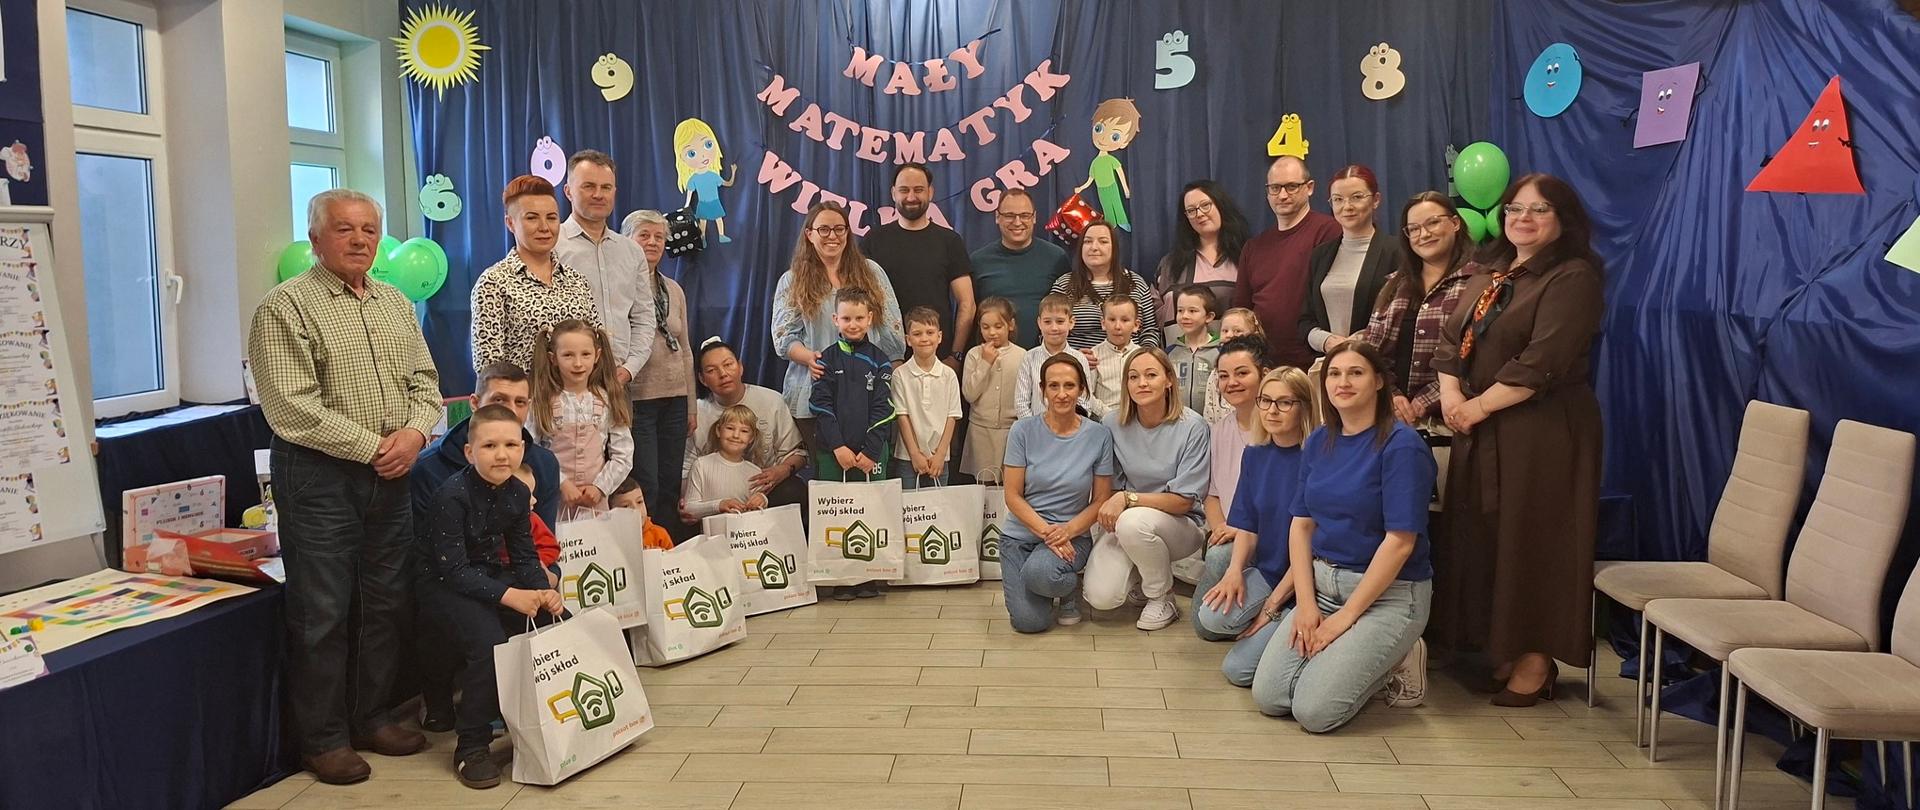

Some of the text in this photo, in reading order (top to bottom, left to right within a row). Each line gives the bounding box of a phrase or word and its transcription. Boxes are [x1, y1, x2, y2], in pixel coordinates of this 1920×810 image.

[843, 40, 985, 95] MAŁY
[1155, 30, 1196, 90] 5
[1360, 42, 1406, 100] 8
[757, 59, 1071, 165] MATEMATYK
[1267, 113, 1310, 160] 4
[970, 139, 1070, 213] GRA
[419, 173, 463, 222] 6
[0, 236, 29, 250] RZY
[817, 496, 854, 506] Wybierz
[902, 504, 925, 515] ybierz
[817, 507, 865, 516] swój skład
[914, 512, 937, 522] skład
[730, 537, 769, 549] swój skład
[569, 546, 597, 560] skład
[669, 572, 696, 587] skład
[551, 655, 580, 676] skład
